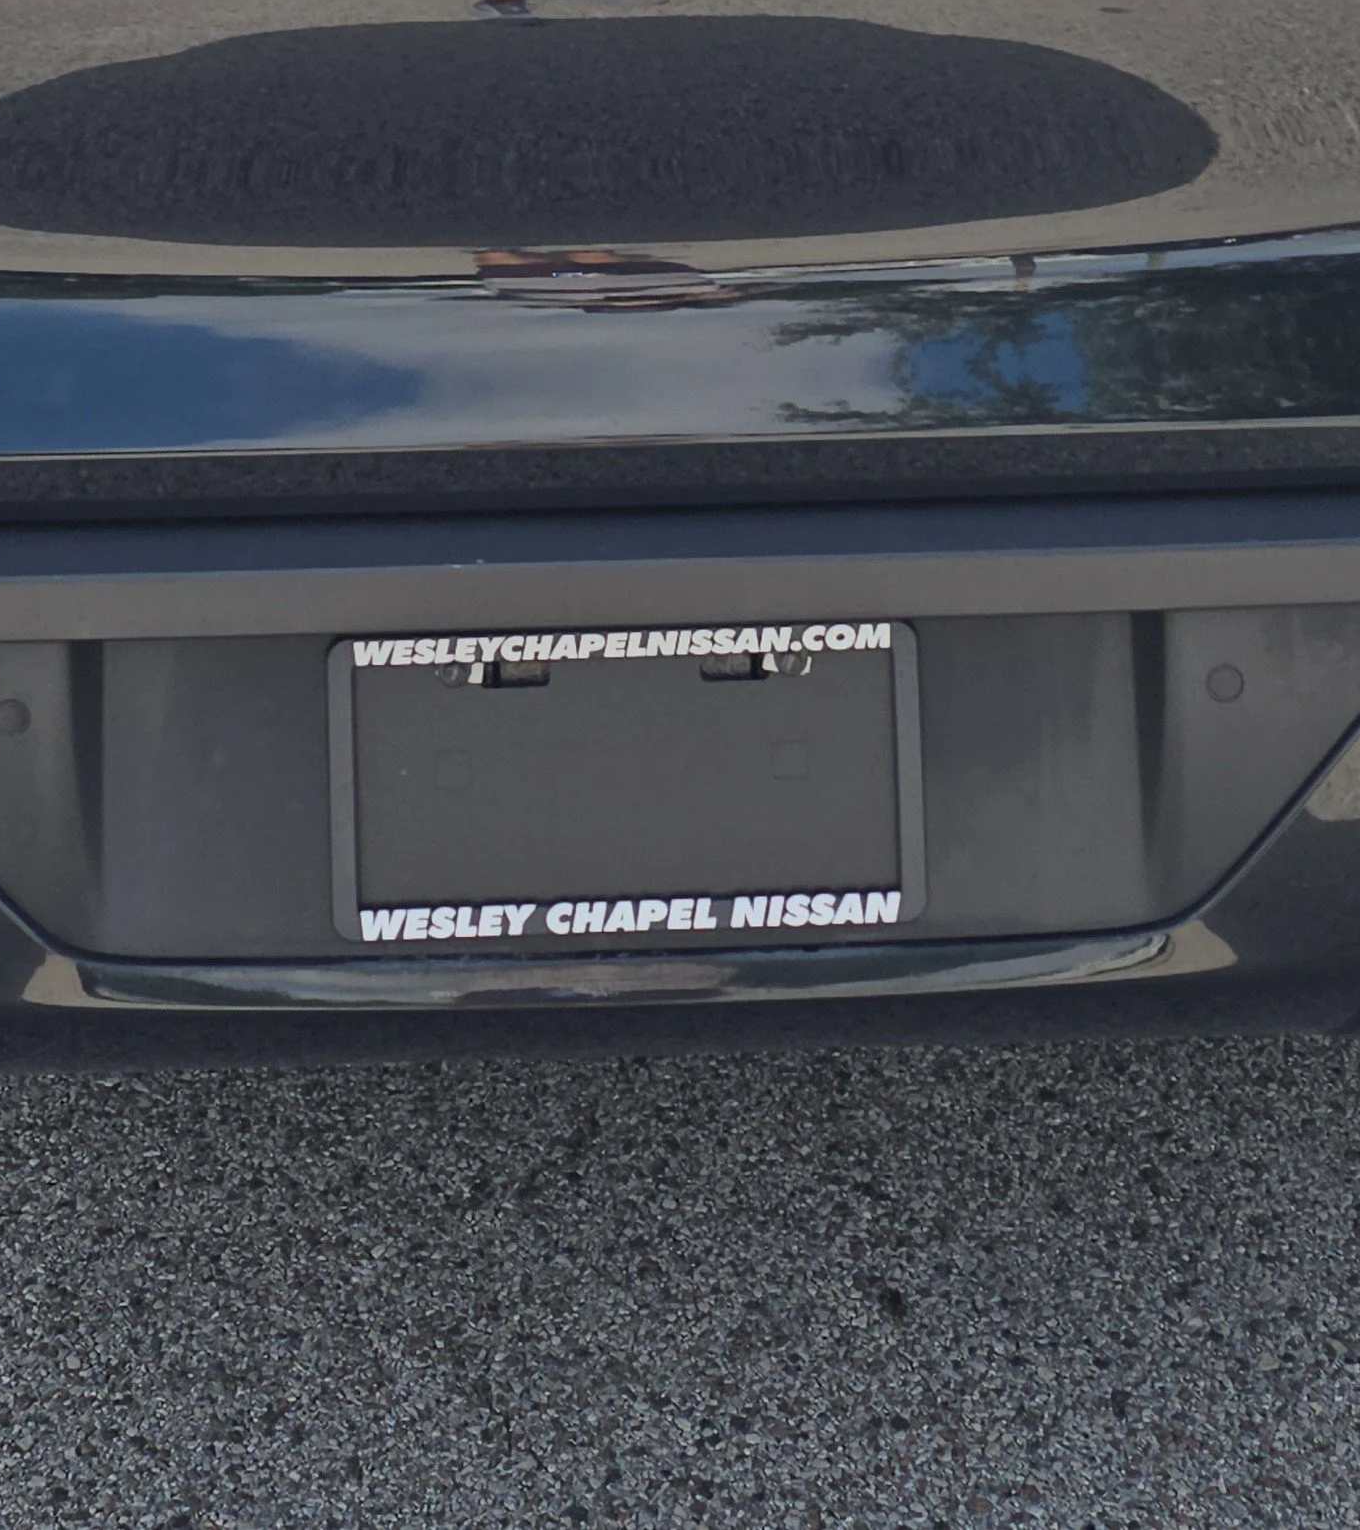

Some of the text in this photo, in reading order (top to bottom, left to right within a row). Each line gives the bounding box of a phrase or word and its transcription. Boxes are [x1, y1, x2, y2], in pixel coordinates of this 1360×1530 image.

[352, 622, 891, 666] WESLEYCHAPELNISSAN.COM
[359, 891, 902, 942] WESLEY CHAPEL NISSAN
